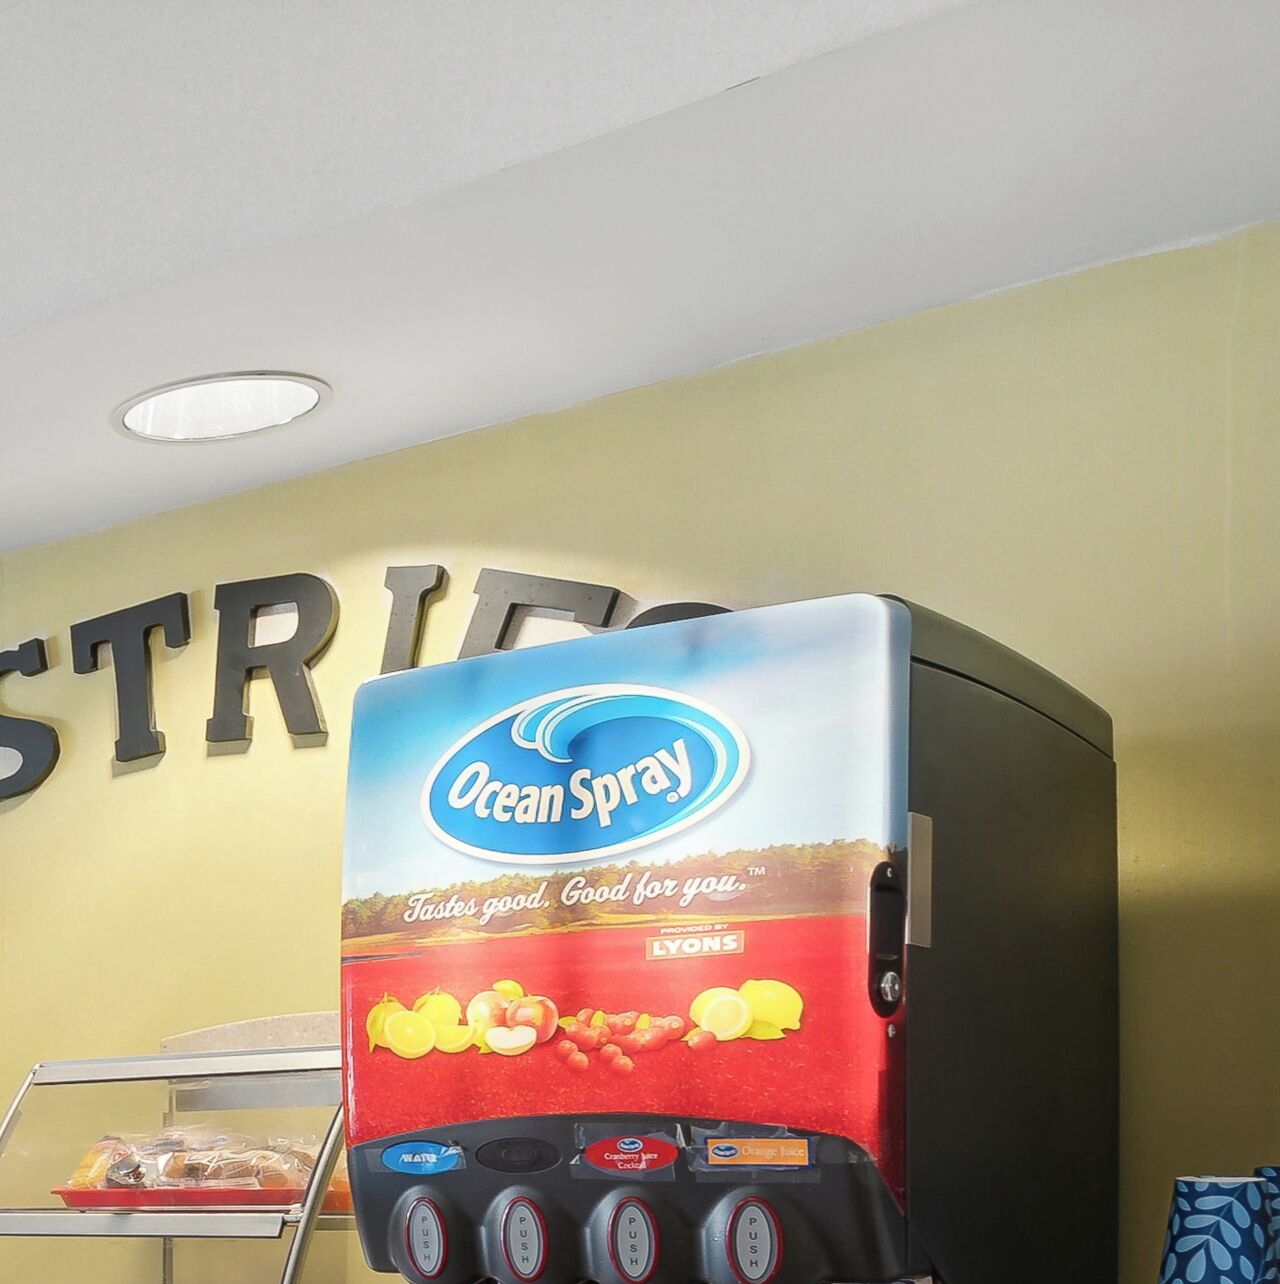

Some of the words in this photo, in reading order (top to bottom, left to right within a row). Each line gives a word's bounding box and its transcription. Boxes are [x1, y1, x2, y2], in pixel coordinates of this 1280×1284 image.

[447, 760, 565, 824] Ocean
[568, 738, 692, 829] Spray
[403, 891, 477, 925] Tastes
[481, 881, 551, 926] good.
[560, 874, 631, 907] Good
[634, 871, 678, 907] for
[652, 934, 738, 957] LYONS
[659, 924, 713, 934] PROVIDED
[714, 922, 729, 931] BY
[604, 1152, 640, 1162] Cranberry
[741, 1145, 777, 1159] Orange
[780, 1145, 805, 1157] Juice
[420, 1215, 431, 1261] PUSH
[519, 1216, 529, 1263] PUSH
[628, 1217, 639, 1265] PUSH
[748, 1217, 759, 1267] PUSH
